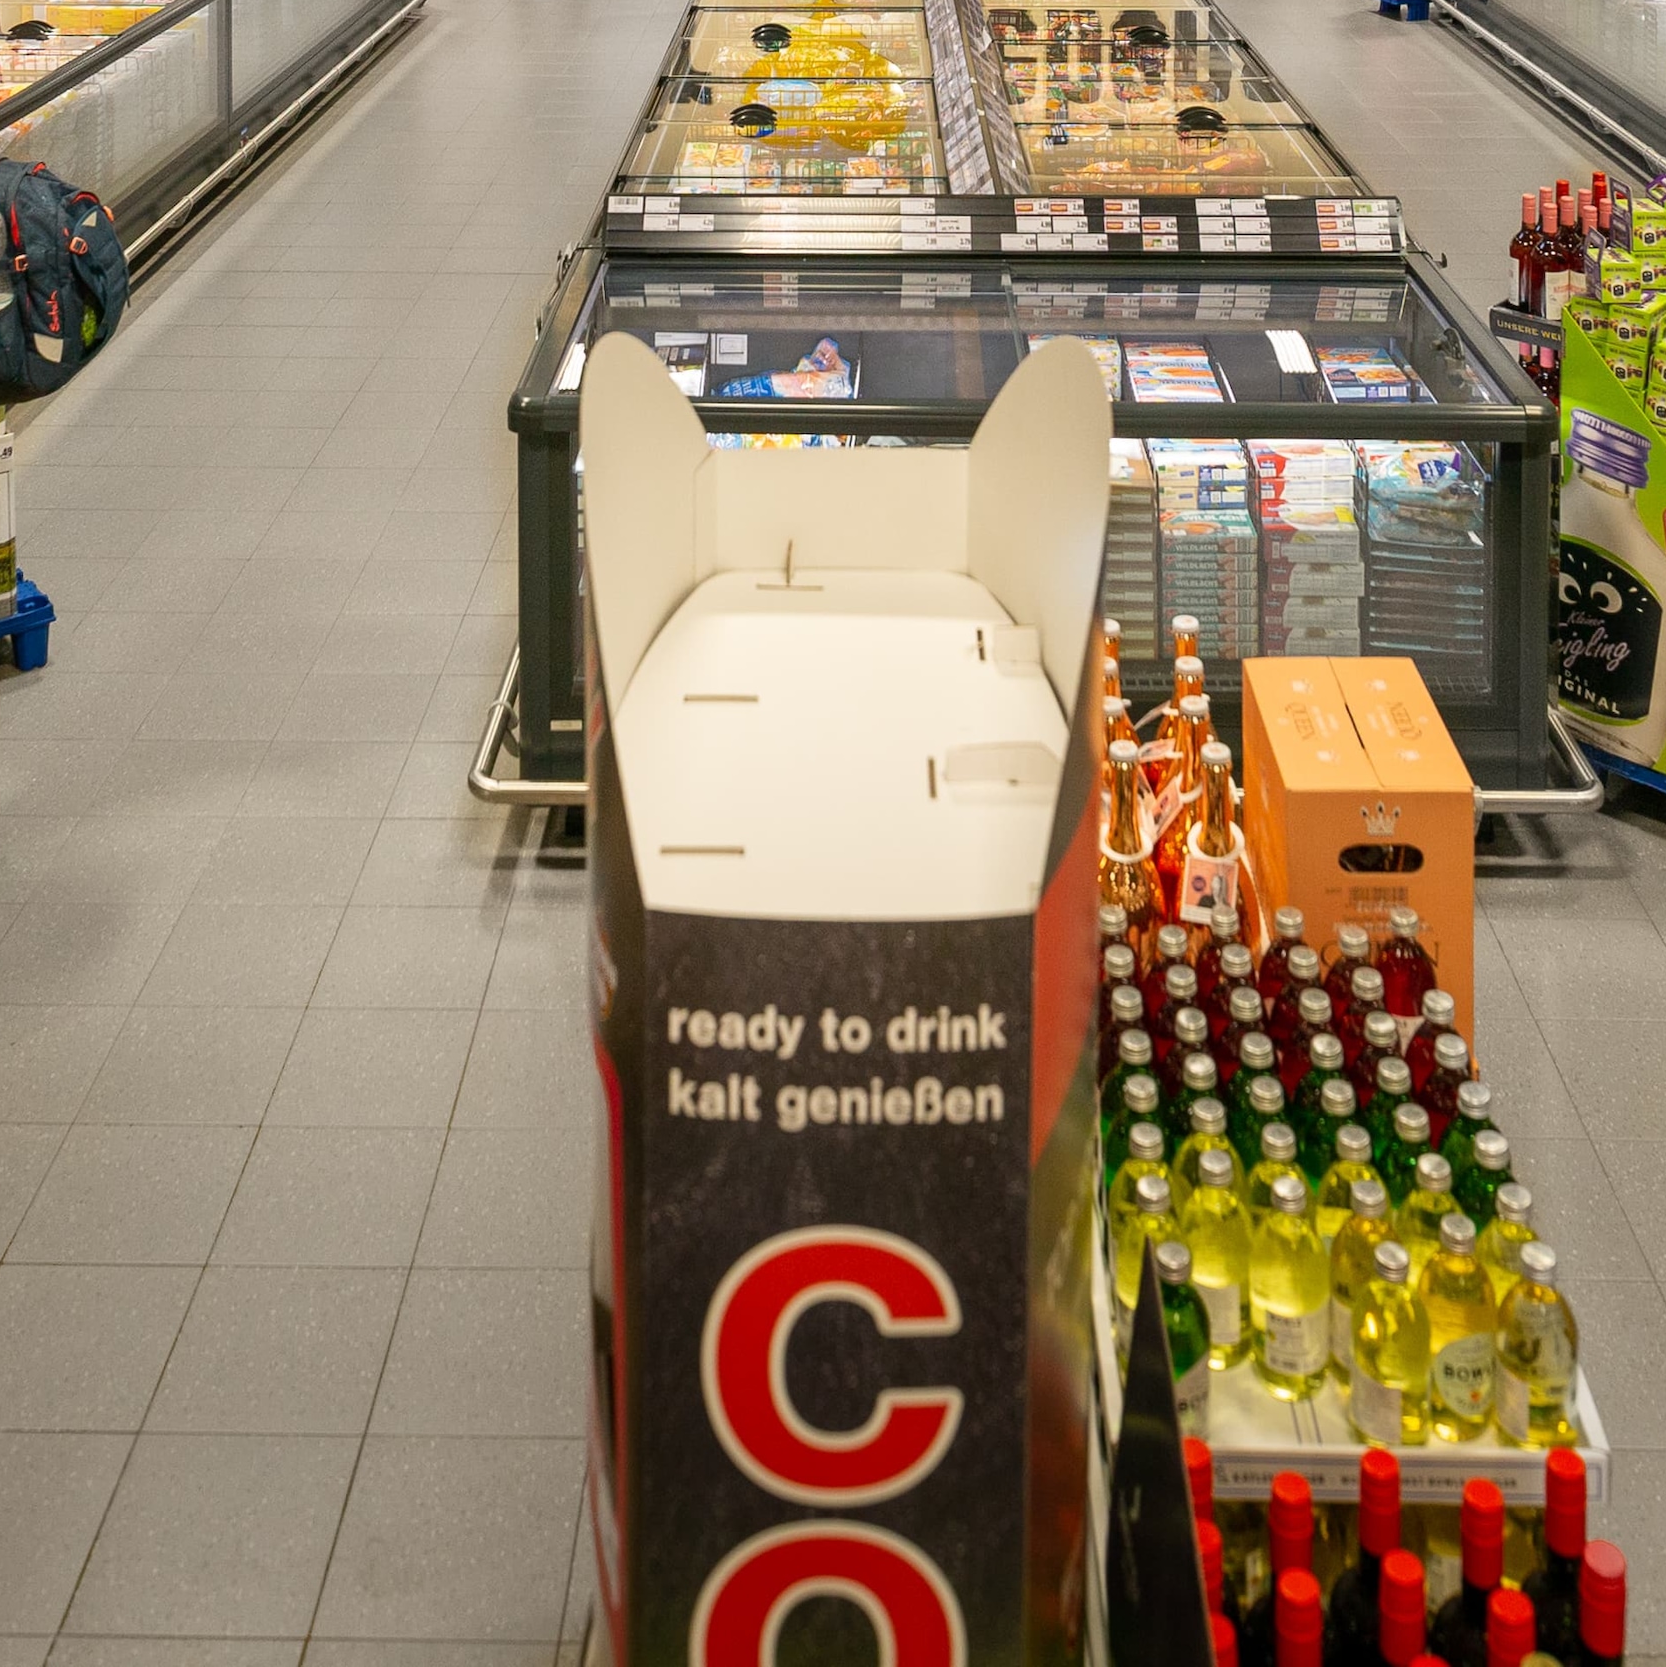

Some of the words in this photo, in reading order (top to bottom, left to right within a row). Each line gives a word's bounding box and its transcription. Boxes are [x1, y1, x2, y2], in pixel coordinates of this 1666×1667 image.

[1497, 319, 1538, 336] UNSERE
[1182, 513, 1247, 523] WILDLACHS
[1567, 610, 1605, 627] Kleiner
[1554, 631, 1630, 671] eigling
[1564, 669, 1590, 688] DAS
[1556, 672, 1622, 715] IGINAL
[668, 1004, 805, 1061] ready
[820, 1008, 873, 1054] to
[886, 1002, 1007, 1054] drink
[668, 1067, 762, 1123] kalt
[774, 1075, 1005, 1133] genießen
